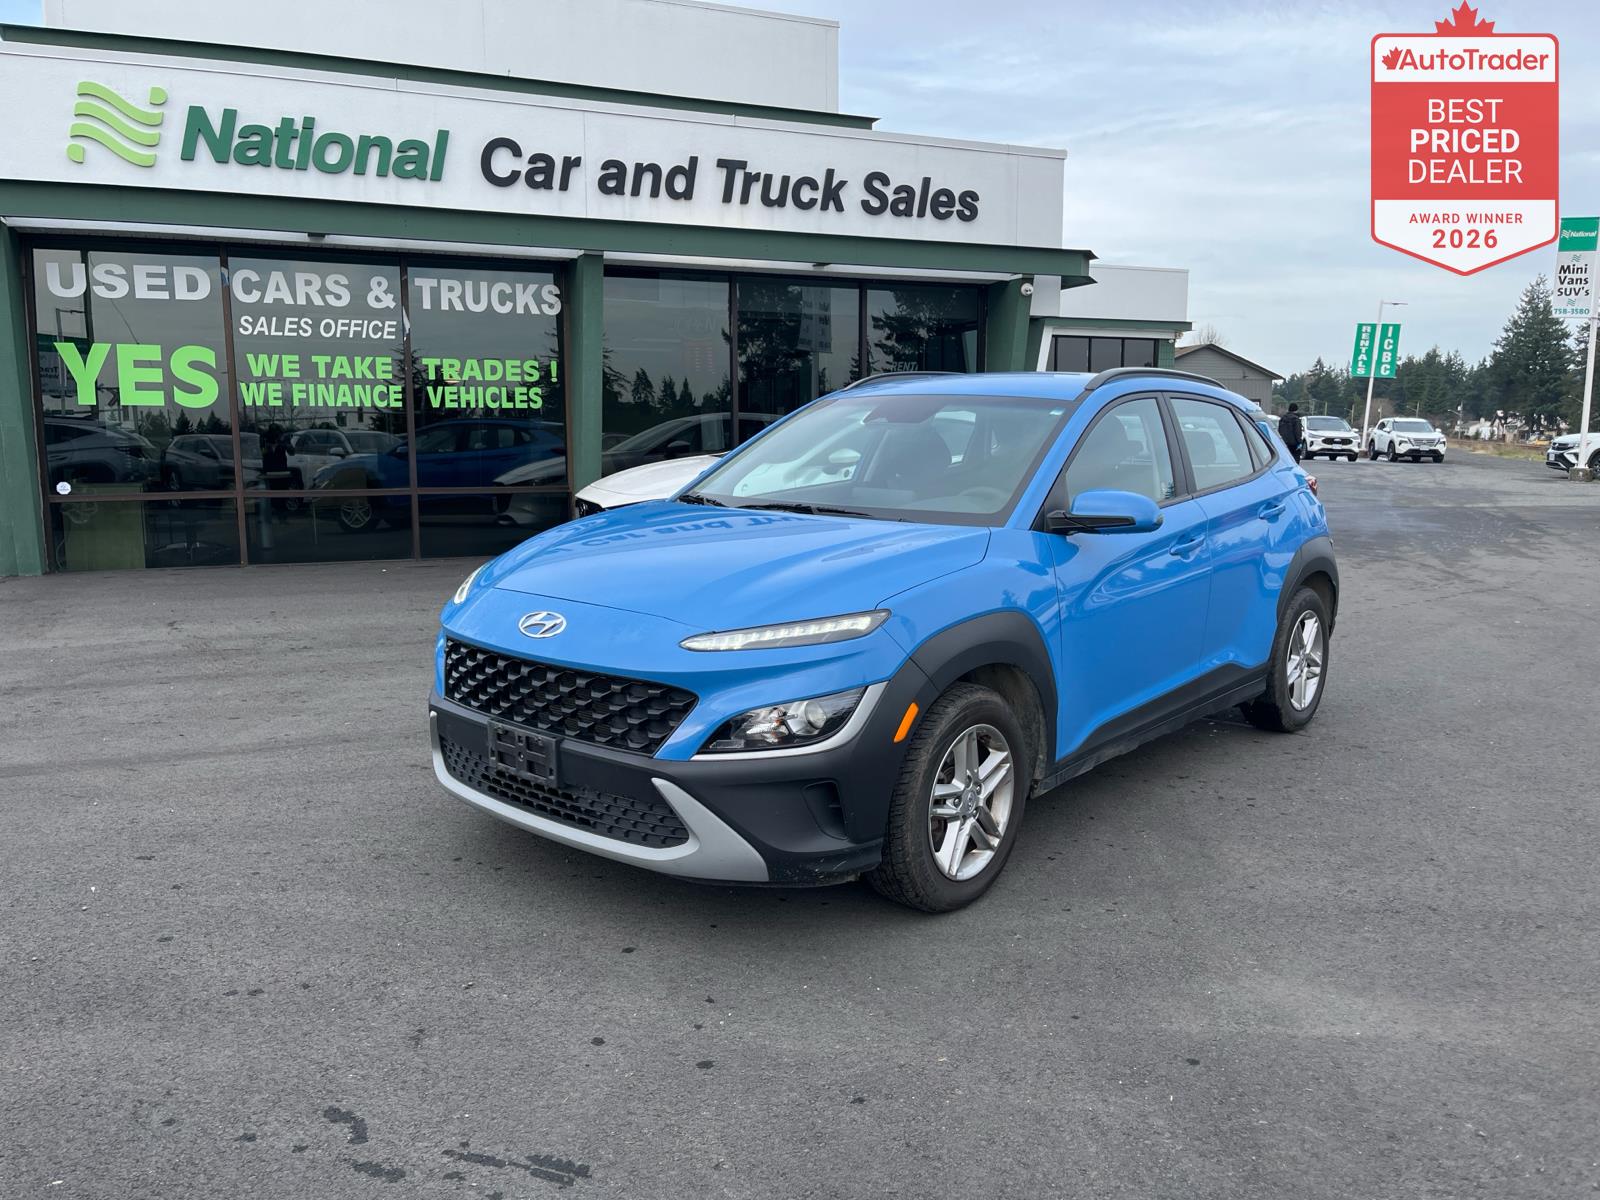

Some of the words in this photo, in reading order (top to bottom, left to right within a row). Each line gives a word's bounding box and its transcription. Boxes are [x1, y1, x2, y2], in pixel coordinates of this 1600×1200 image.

[180, 105, 450, 182] National
[480, 137, 582, 192] Car
[598, 155, 698, 201] and
[716, 158, 848, 212] Truck
[861, 171, 980, 222] Sales
[1570, 230, 1597, 238] National
[1558, 263, 1588, 275] Mini
[1558, 275, 1589, 285] Vans
[45, 262, 211, 300] USED
[232, 269, 351, 307] CARS
[366, 276, 396, 309] &
[414, 277, 562, 316] TRUCKS
[1557, 287, 1590, 296] SUV's
[1553, 307, 1590, 315] 758-3580
[238, 315, 312, 337] SALES
[319, 318, 397, 339] OFFICE
[1380, 326, 1394, 375] ICBC
[53, 342, 219, 409] YES
[246, 354, 300, 379] WE
[311, 355, 392, 380] TAKE
[422, 358, 540, 382] TRADES
[239, 382, 282, 407] WE
[292, 383, 403, 408] FINANCE
[426, 386, 543, 409] VEHICLES
